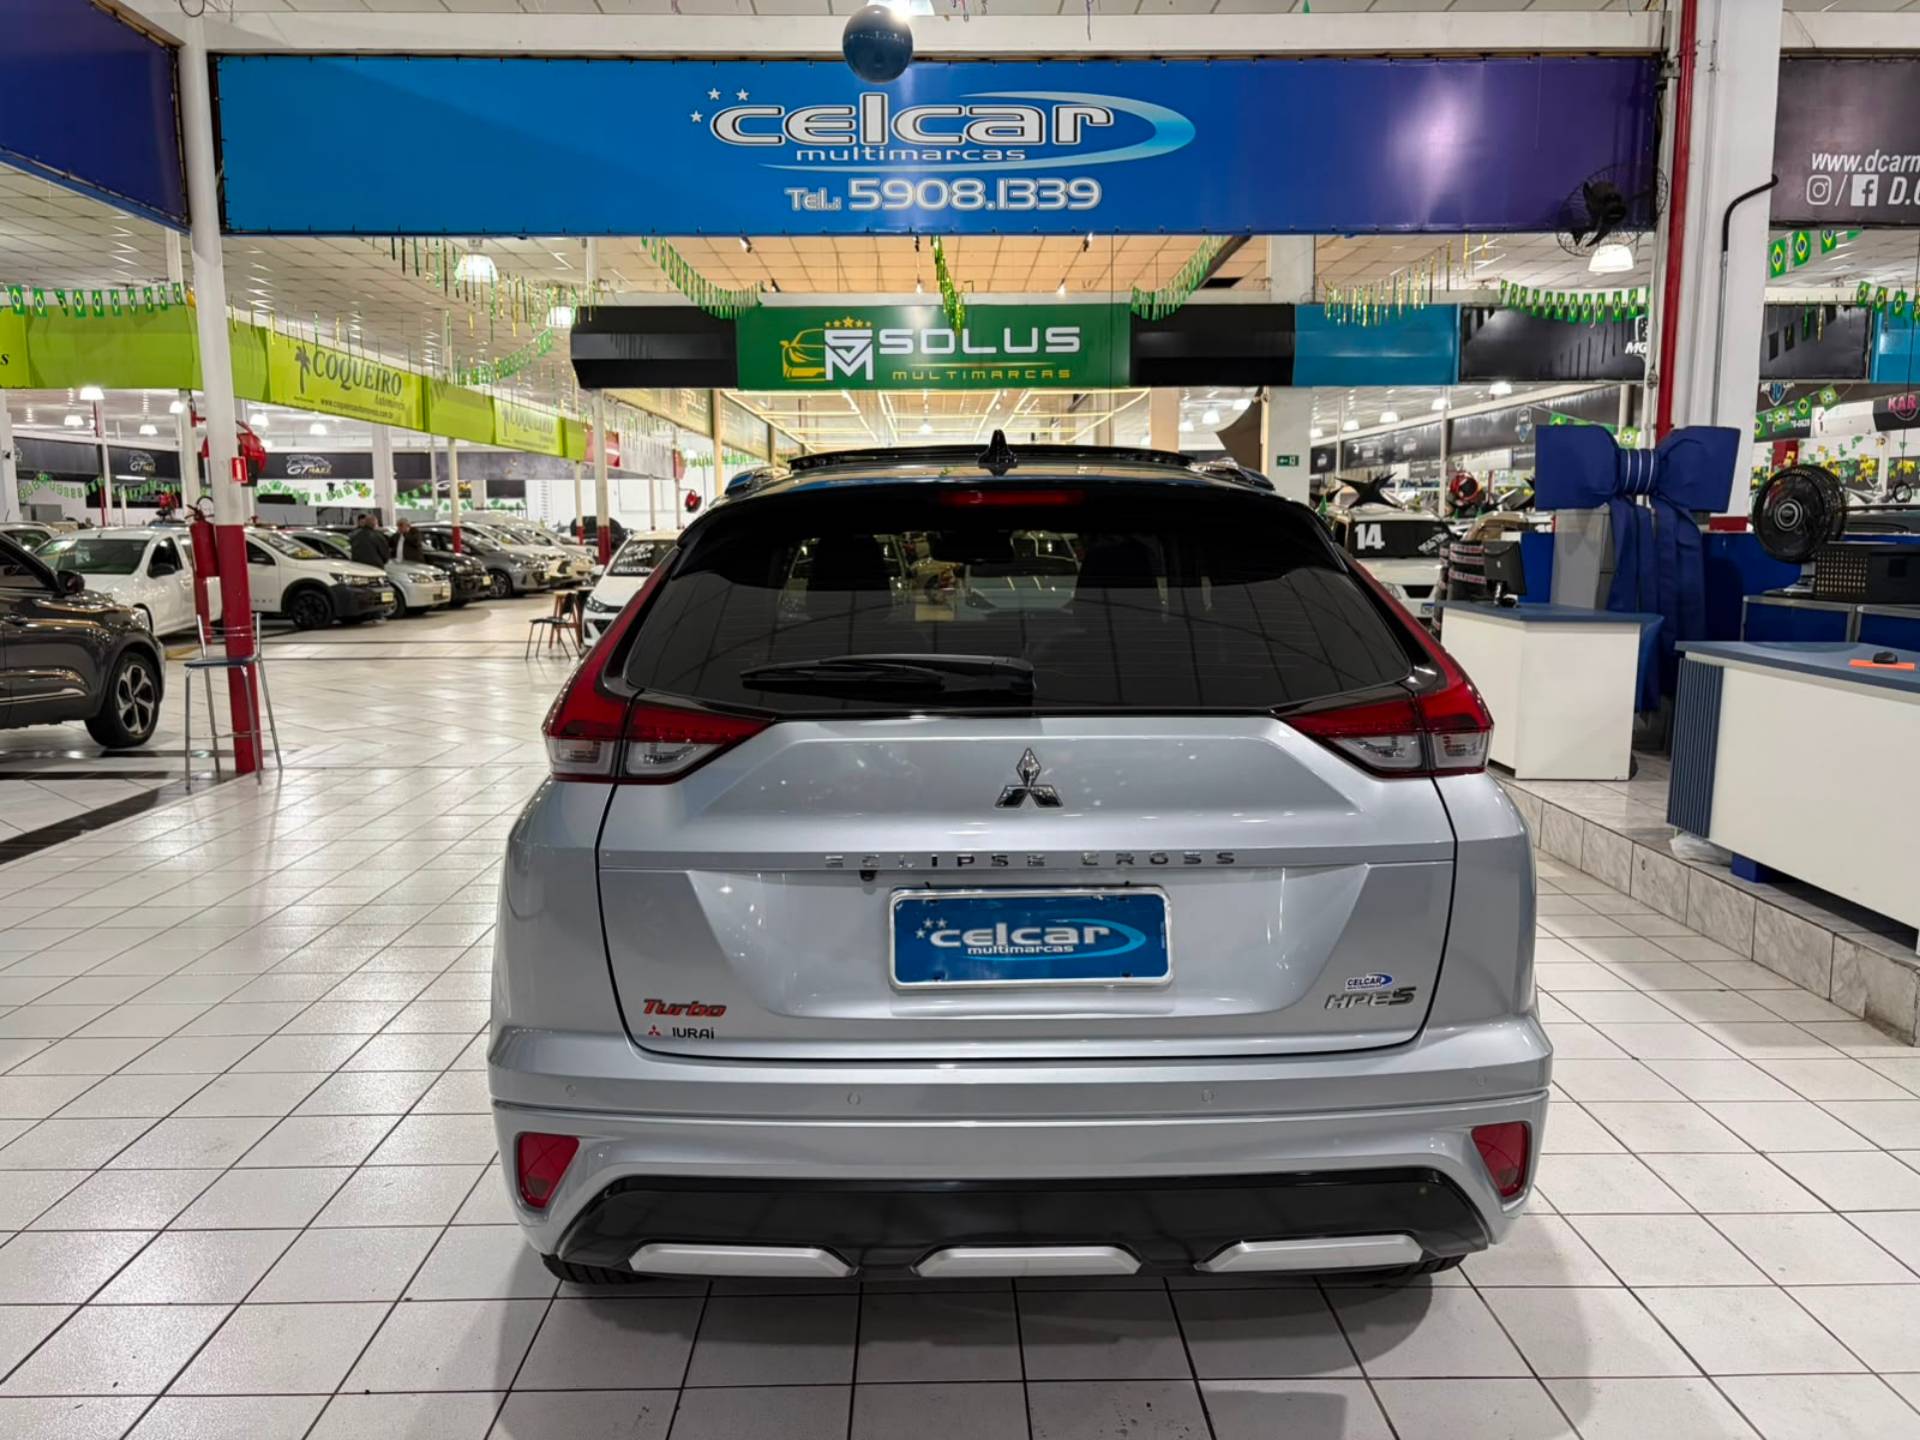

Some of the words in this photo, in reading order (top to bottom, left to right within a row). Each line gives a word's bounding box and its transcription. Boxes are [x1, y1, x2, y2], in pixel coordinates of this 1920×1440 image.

[710, 93, 1114, 146] celcar
[796, 146, 1026, 162] multimarcas
[848, 177, 1101, 212] 5908.1339
[879, 326, 1081, 355] SOLUS
[313, 350, 403, 396] COQUEIRO
[1354, 524, 1385, 550] 14
[824, 853, 1046, 869] ECLIPSE
[1081, 852, 1236, 867] CROSS
[930, 922, 1110, 948] celcar
[966, 944, 1075, 956] multimarcas
[643, 998, 727, 1018] Turbo
